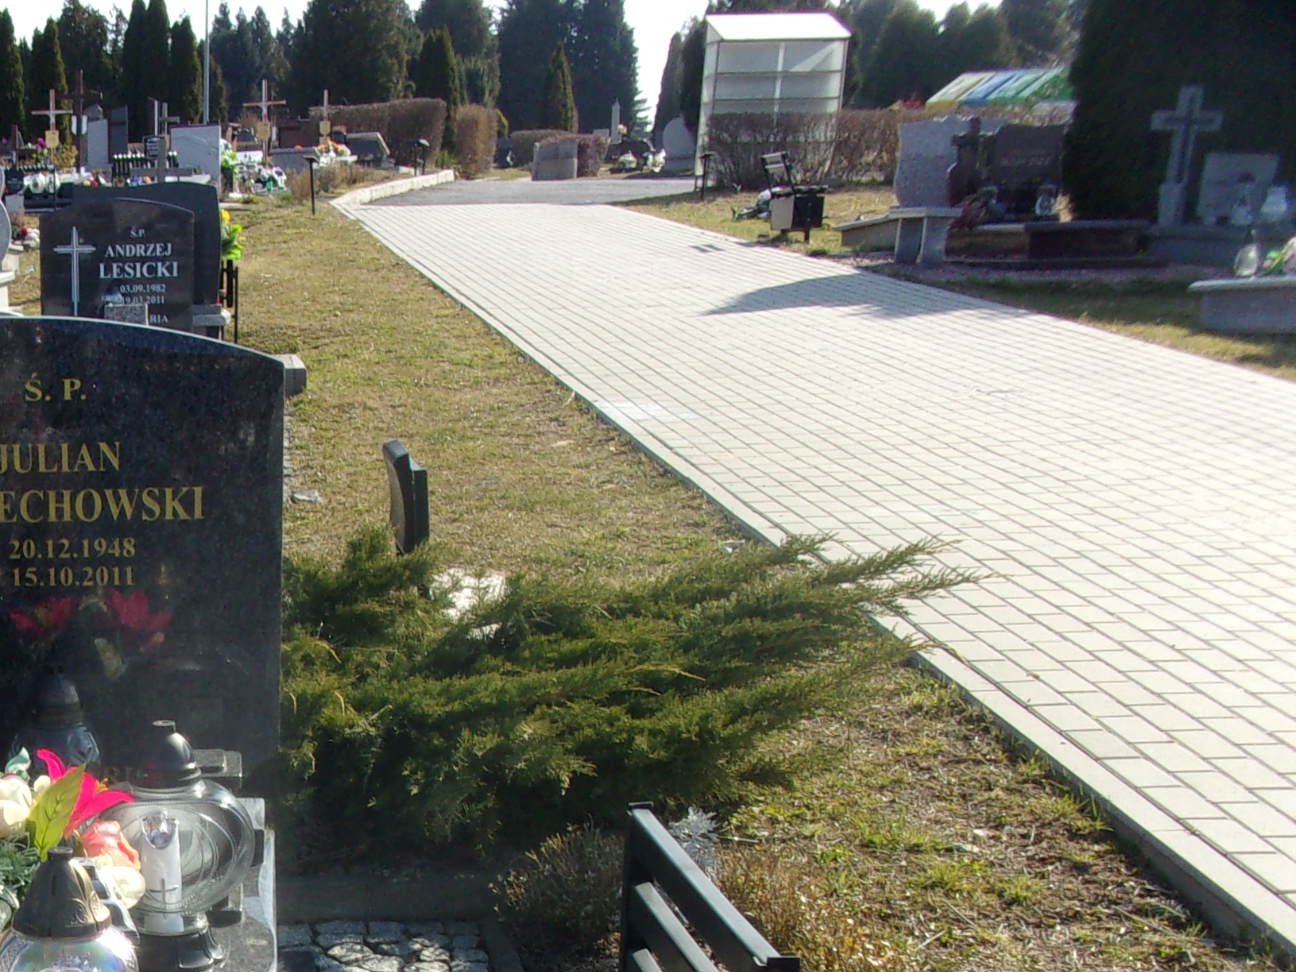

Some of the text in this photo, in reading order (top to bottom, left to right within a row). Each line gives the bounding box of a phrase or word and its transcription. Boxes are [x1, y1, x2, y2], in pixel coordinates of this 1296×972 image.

[105, 243, 172, 257] ANDRZEJ
[99, 261, 179, 279] LESICKI
[63, 378, 87, 400] P.
[8, 537, 136, 561] 20.12.1948
[12, 565, 135, 587] 15.10.2011
